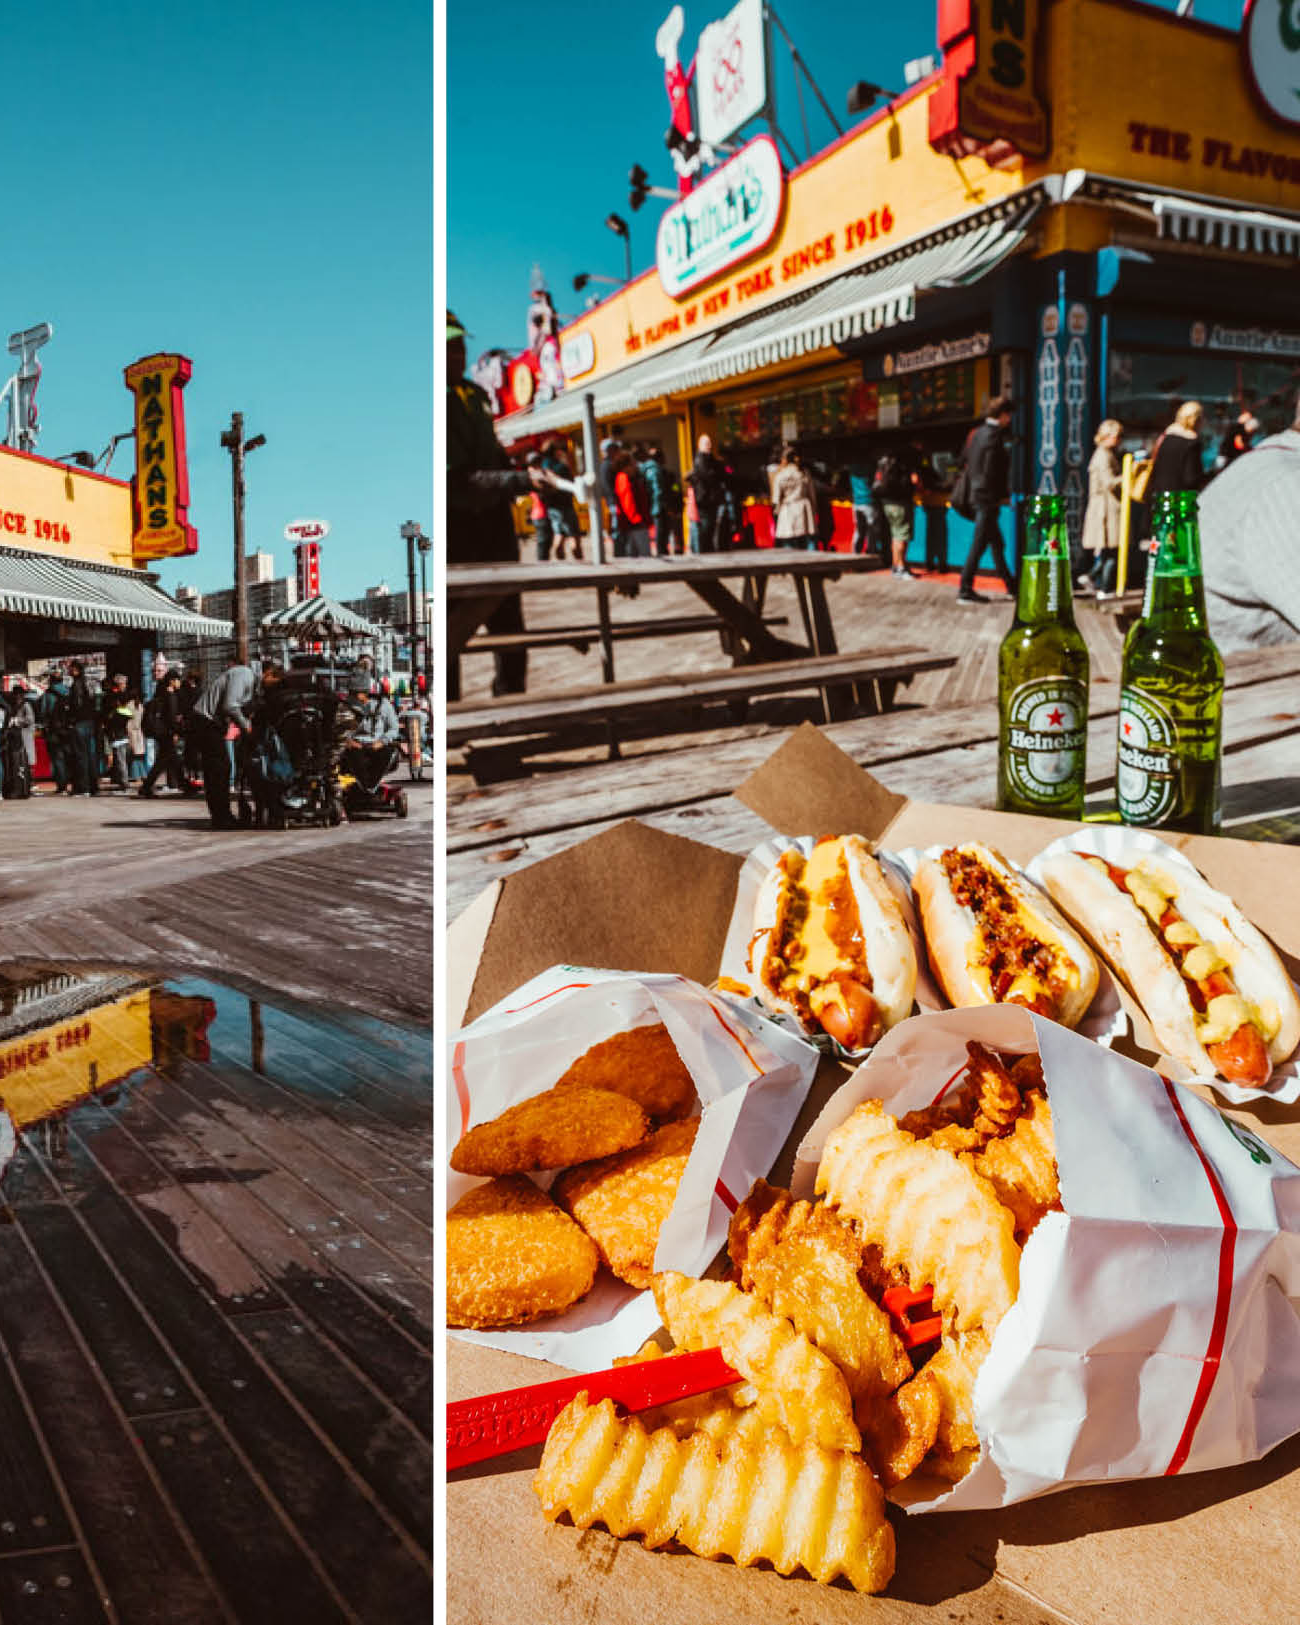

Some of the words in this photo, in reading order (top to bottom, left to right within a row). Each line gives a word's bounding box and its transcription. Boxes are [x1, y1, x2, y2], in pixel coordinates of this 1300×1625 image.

[1127, 121, 1191, 163] THE
[782, 233, 835, 282] SINCE
[845, 203, 894, 252] 1916
[142, 372, 169, 529] NATHANS
[34, 518, 71, 545] 1916
[1011, 729, 1085, 750] Heineke
